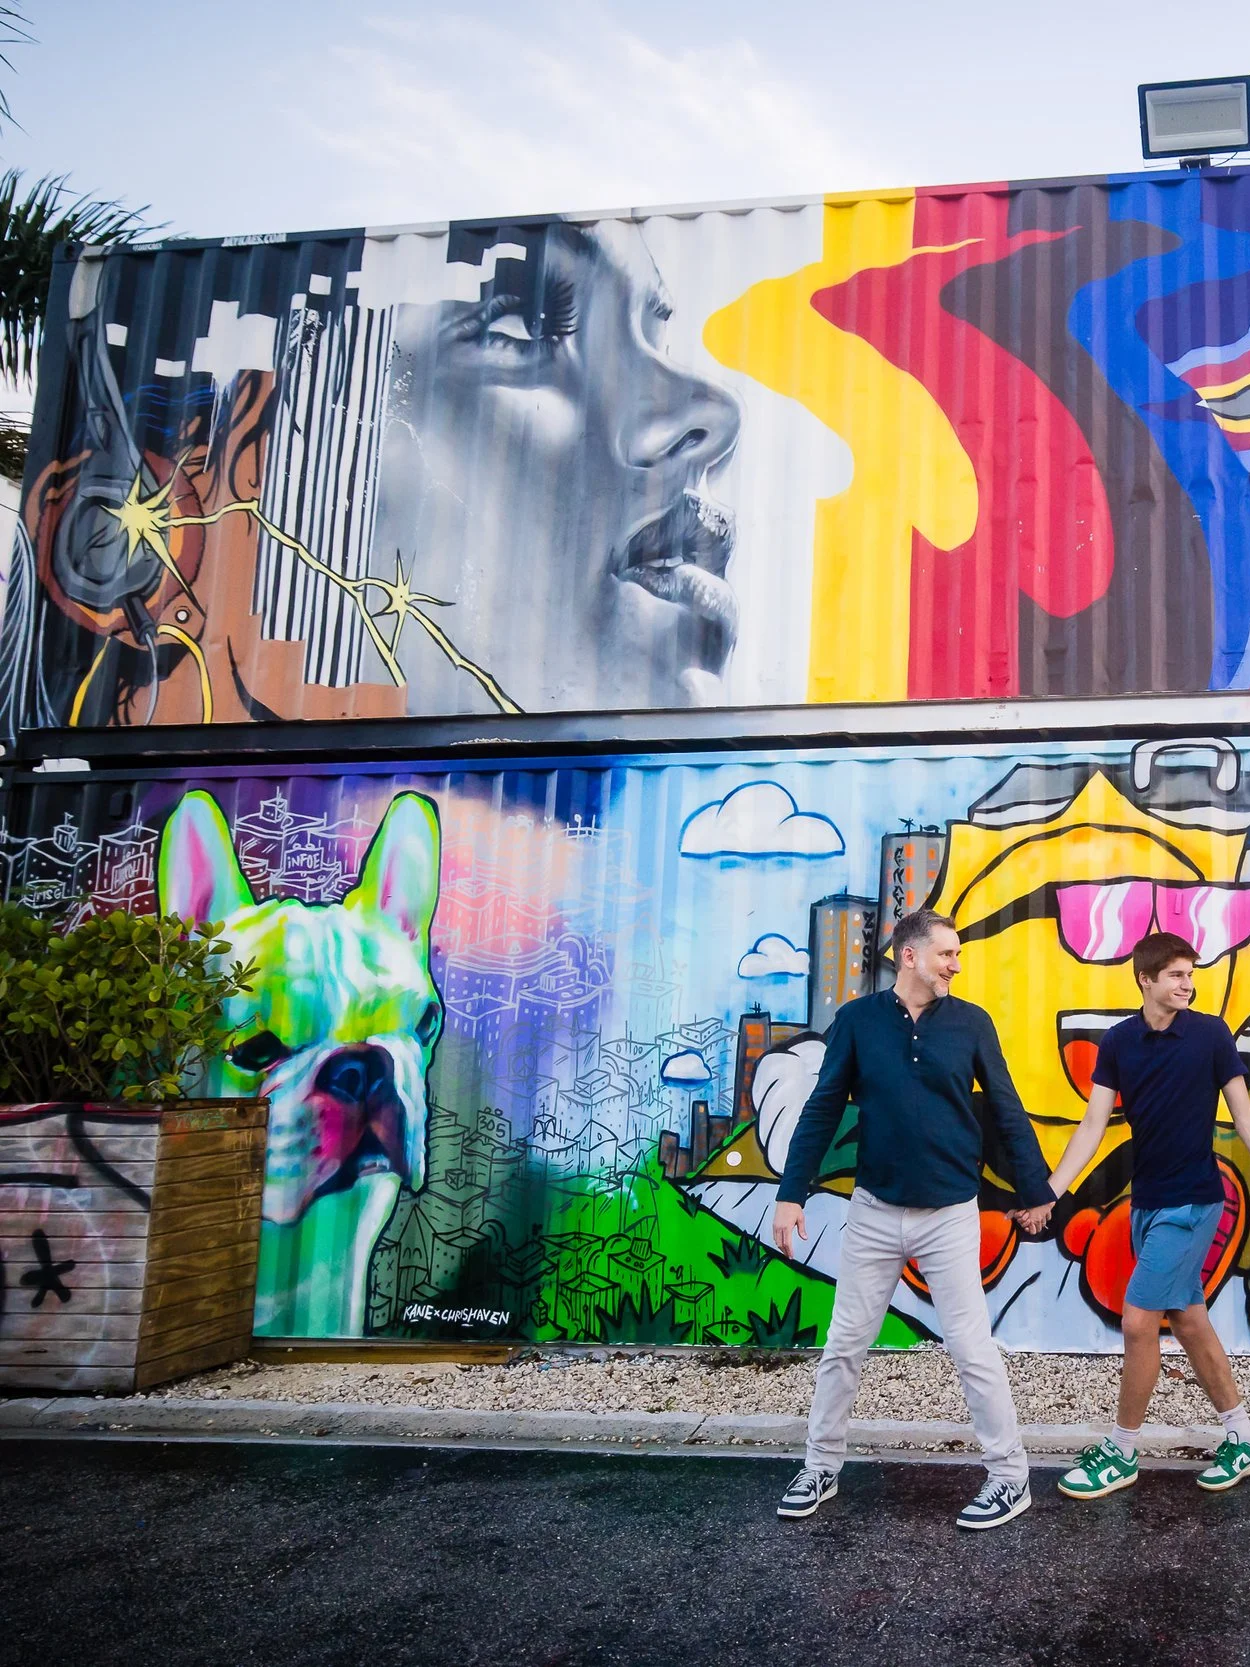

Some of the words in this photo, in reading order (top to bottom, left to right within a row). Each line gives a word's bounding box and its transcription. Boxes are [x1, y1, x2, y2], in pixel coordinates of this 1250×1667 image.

[479, 1115, 506, 1139] 305
[404, 1304, 434, 1322] KANE
[441, 1308, 510, 1326] CHRISHAVEN
